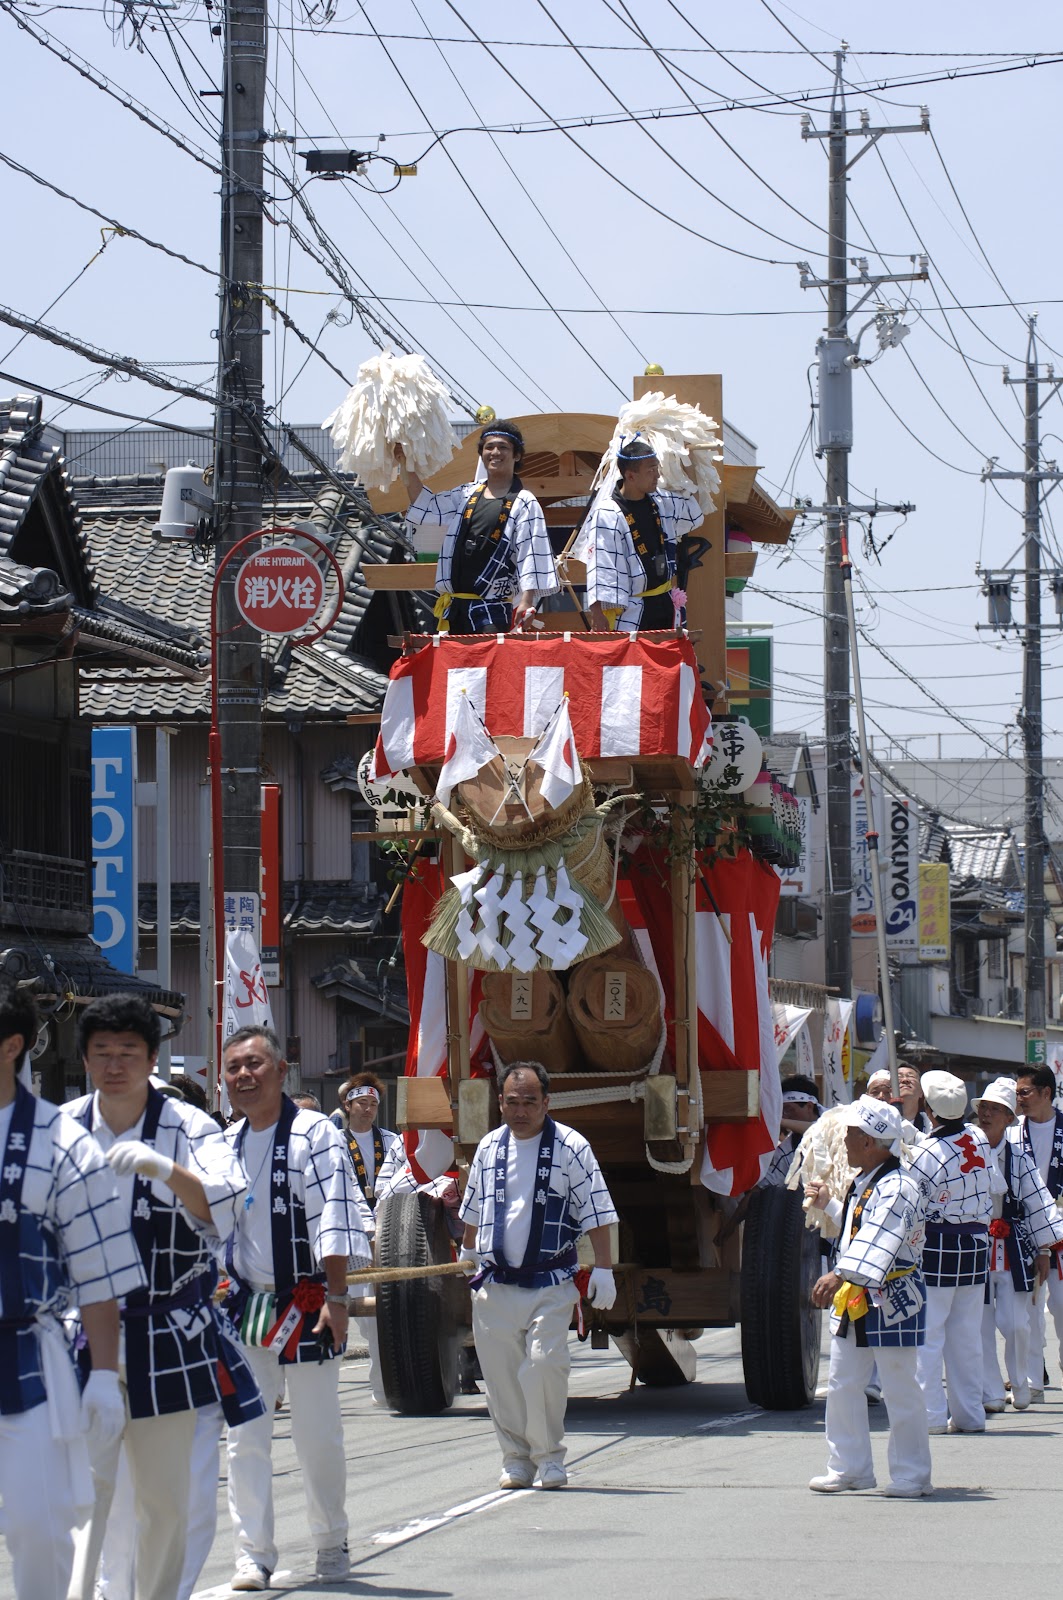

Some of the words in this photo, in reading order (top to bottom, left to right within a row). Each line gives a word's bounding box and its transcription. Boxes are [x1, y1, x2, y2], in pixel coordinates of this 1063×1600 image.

[254, 557, 271, 567] FIRE
[272, 557, 305, 567] HYDRANT
[244, 576, 316, 609] 消火栓
[91, 757, 126, 949] TOTO
[891, 801, 910, 901] KOKUYO
[514, 978, 530, 1013] 一八九一
[535, 1147, 551, 1206] 王中島
[1050, 1128, 1063, 1169] 王中島
[1, 1133, 26, 1224] 王中島
[272, 1145, 288, 1216] 王中島
